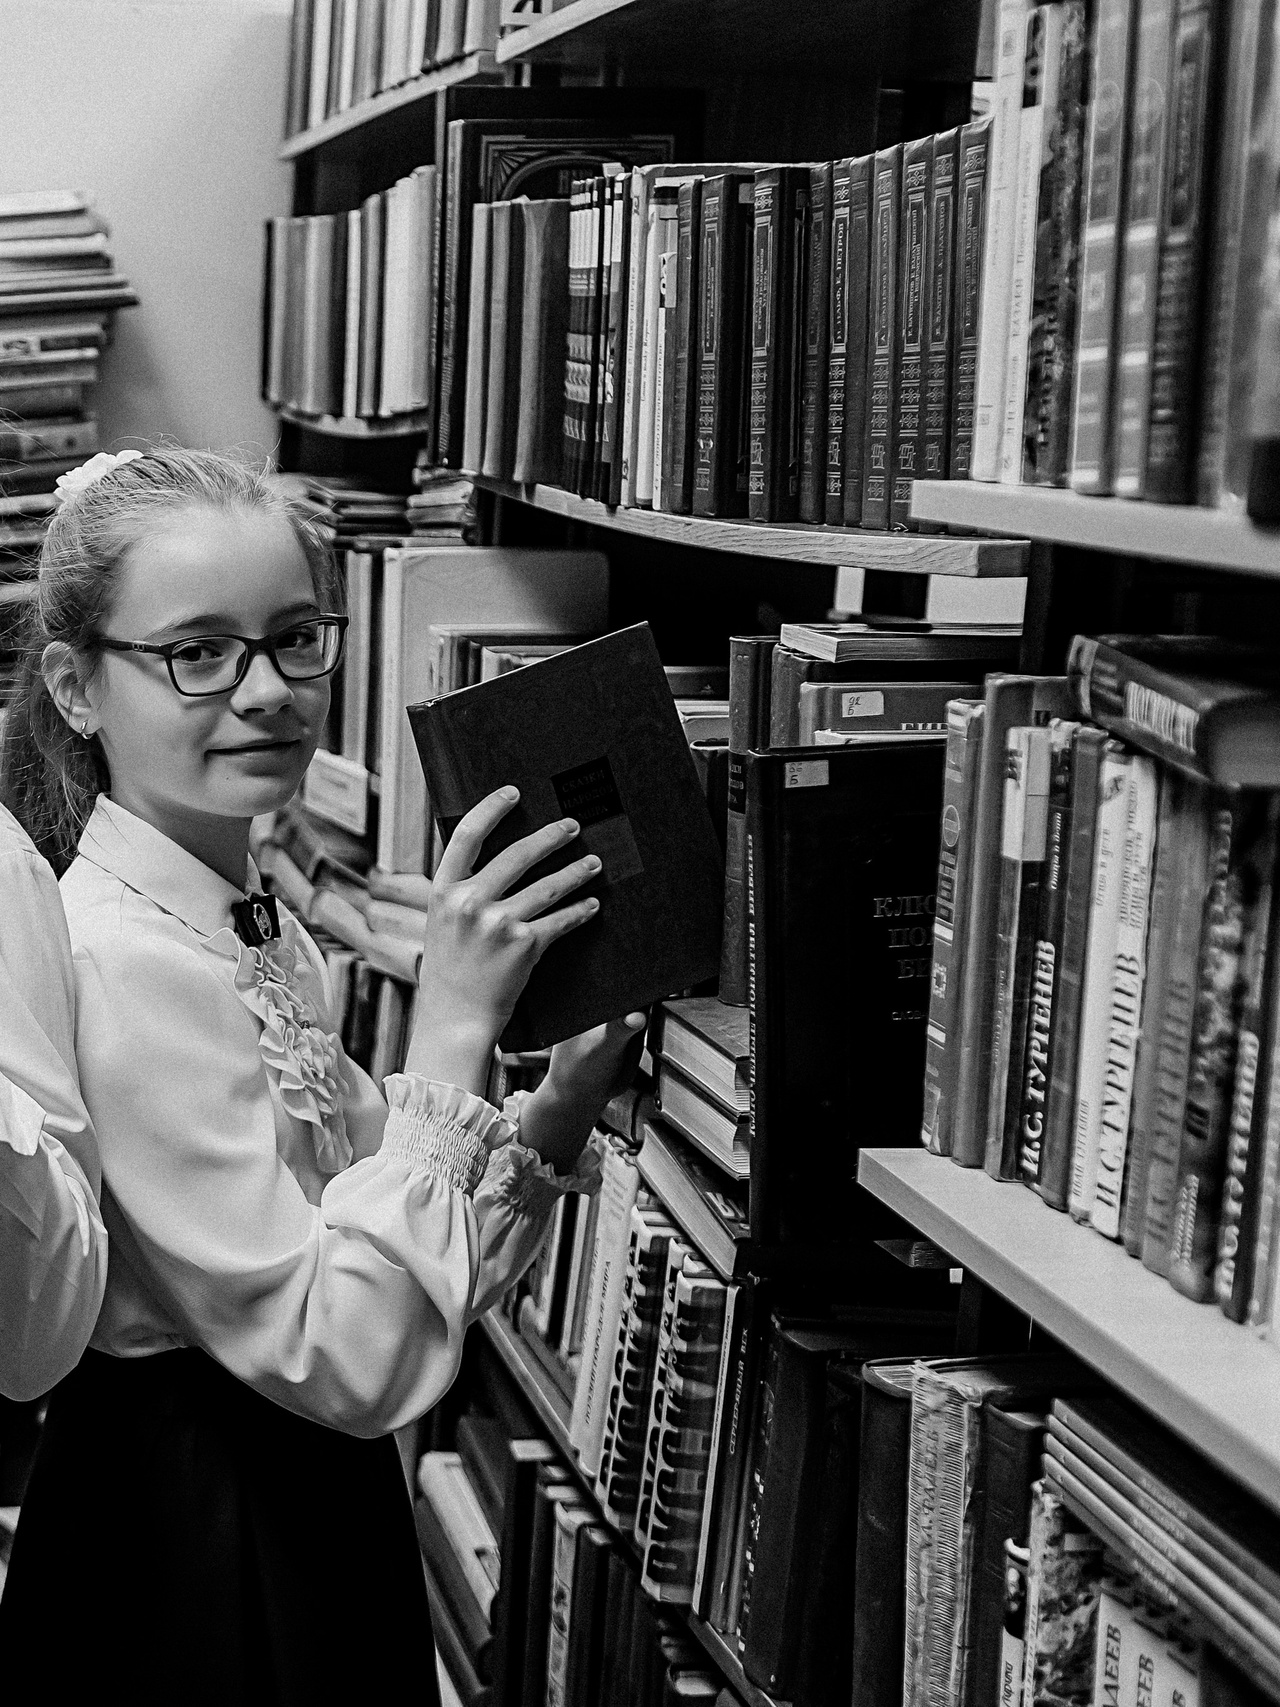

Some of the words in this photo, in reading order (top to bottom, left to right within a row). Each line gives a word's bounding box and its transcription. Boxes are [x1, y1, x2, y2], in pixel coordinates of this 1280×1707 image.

[835, 222, 844, 271] ПЕТРОВ
[1011, 277, 1025, 337] КАЗАКИ
[561, 769, 606, 793] СКАЗКИ
[562, 783, 614, 810] НАРОДОВ
[1052, 812, 1062, 843] дети
[1050, 854, 1061, 890] Отцы
[887, 927, 934, 949] ПО
[748, 922, 756, 1018] ПОНЯТИЯ
[1025, 940, 1056, 1102] ТУРГЕНЕВ
[1101, 953, 1140, 1138] ТУРГЕНЕВ
[601, 1260, 612, 1300] МИРА
[728, 1360, 745, 1455] СЕРЕБРЯНЫЙ
[739, 1327, 749, 1354] ВЕК
[1103, 1624, 1122, 1707] ДЕЕВ
